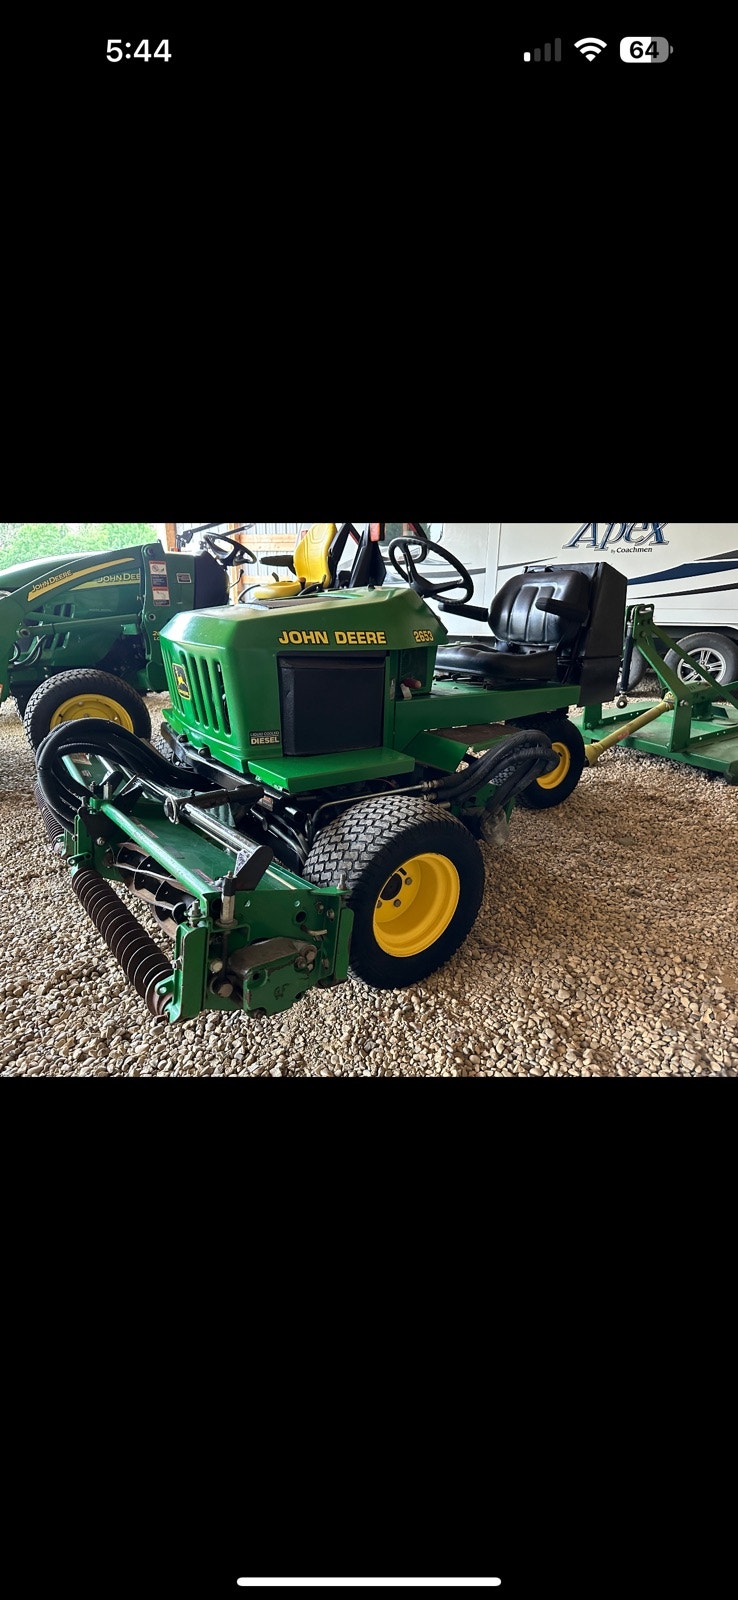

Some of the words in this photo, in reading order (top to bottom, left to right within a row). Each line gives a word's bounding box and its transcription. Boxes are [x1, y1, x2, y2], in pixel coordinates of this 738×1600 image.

[562, 523, 670, 551] Apex
[32, 580, 50, 592] JOHN
[49, 570, 73, 584] DEERE
[97, 575, 122, 583] JOHN
[278, 630, 330, 645] JOHN
[334, 631, 387, 645] DEERE
[413, 630, 434, 643] 2653
[250, 736, 280, 745] DIESEL
